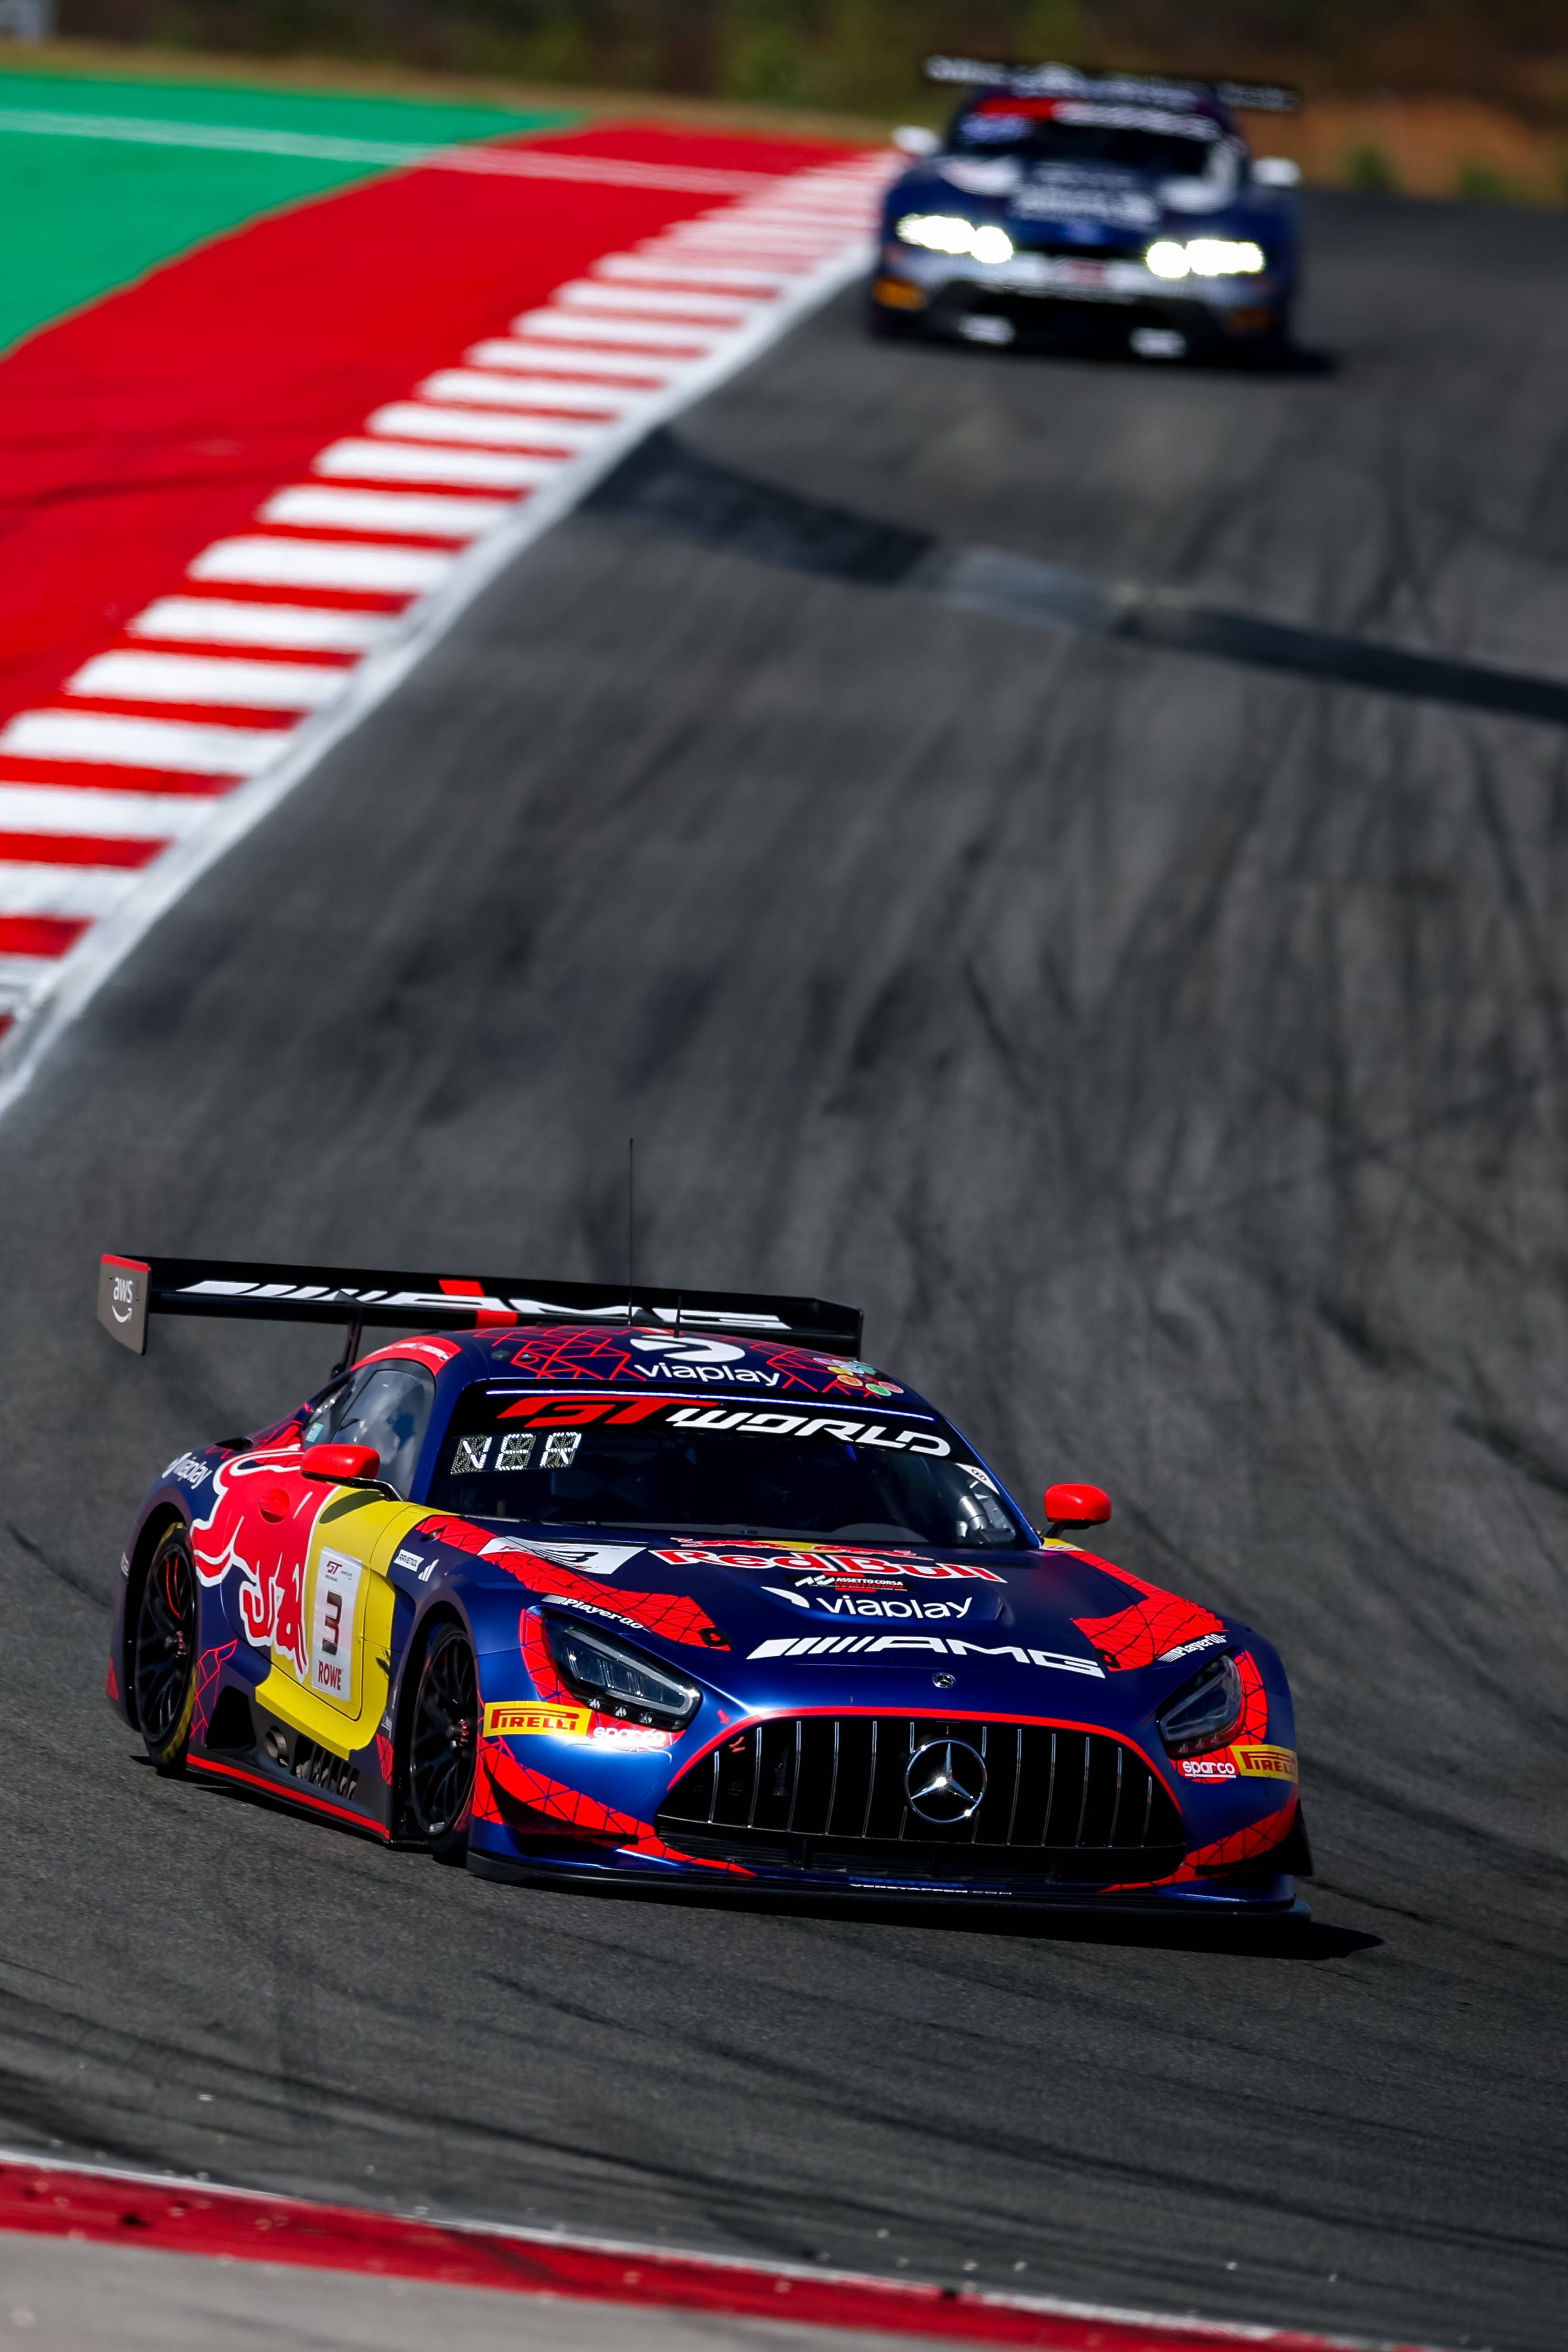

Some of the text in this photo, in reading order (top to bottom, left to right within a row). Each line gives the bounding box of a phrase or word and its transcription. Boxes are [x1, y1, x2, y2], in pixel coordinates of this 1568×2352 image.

[113, 1277, 133, 1304] aws
[634, 1362, 780, 1387] viaplay
[496, 1395, 951, 1457] GT WORLD
[326, 1560, 342, 1575] GT
[649, 1548, 1008, 1583] Red Bull
[815, 1594, 973, 1619] viaplay
[321, 1590, 342, 1656] 3
[318, 1660, 342, 1691] ROWE
[490, 1708, 580, 1731] PIRELLI
[1182, 1760, 1236, 1778] sparco
[1239, 1751, 1297, 1776] PIRELL
